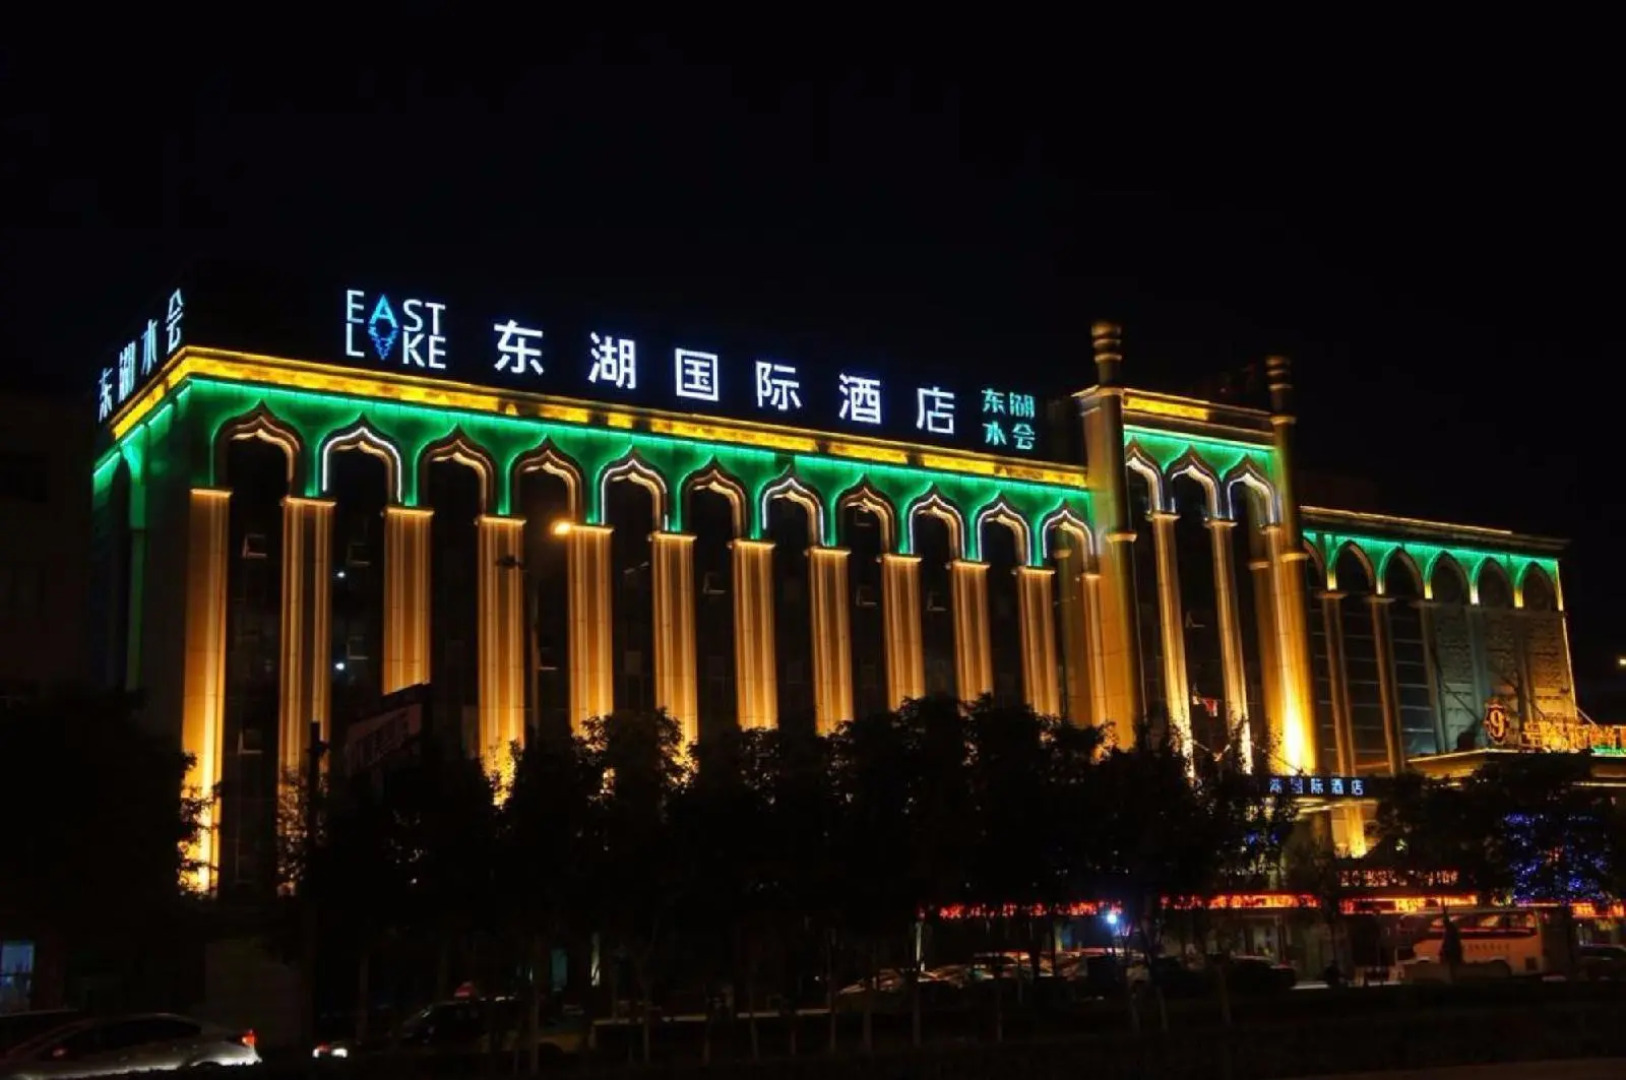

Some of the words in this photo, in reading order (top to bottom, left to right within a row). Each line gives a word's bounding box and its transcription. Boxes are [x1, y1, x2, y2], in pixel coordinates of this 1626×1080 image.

[346, 289, 446, 336] EAST
[98, 288, 184, 422] 东湖水会
[494, 319, 956, 435] 东湖国际酒店
[981, 388, 1035, 418] 东湖
[982, 421, 1036, 450] 水会
